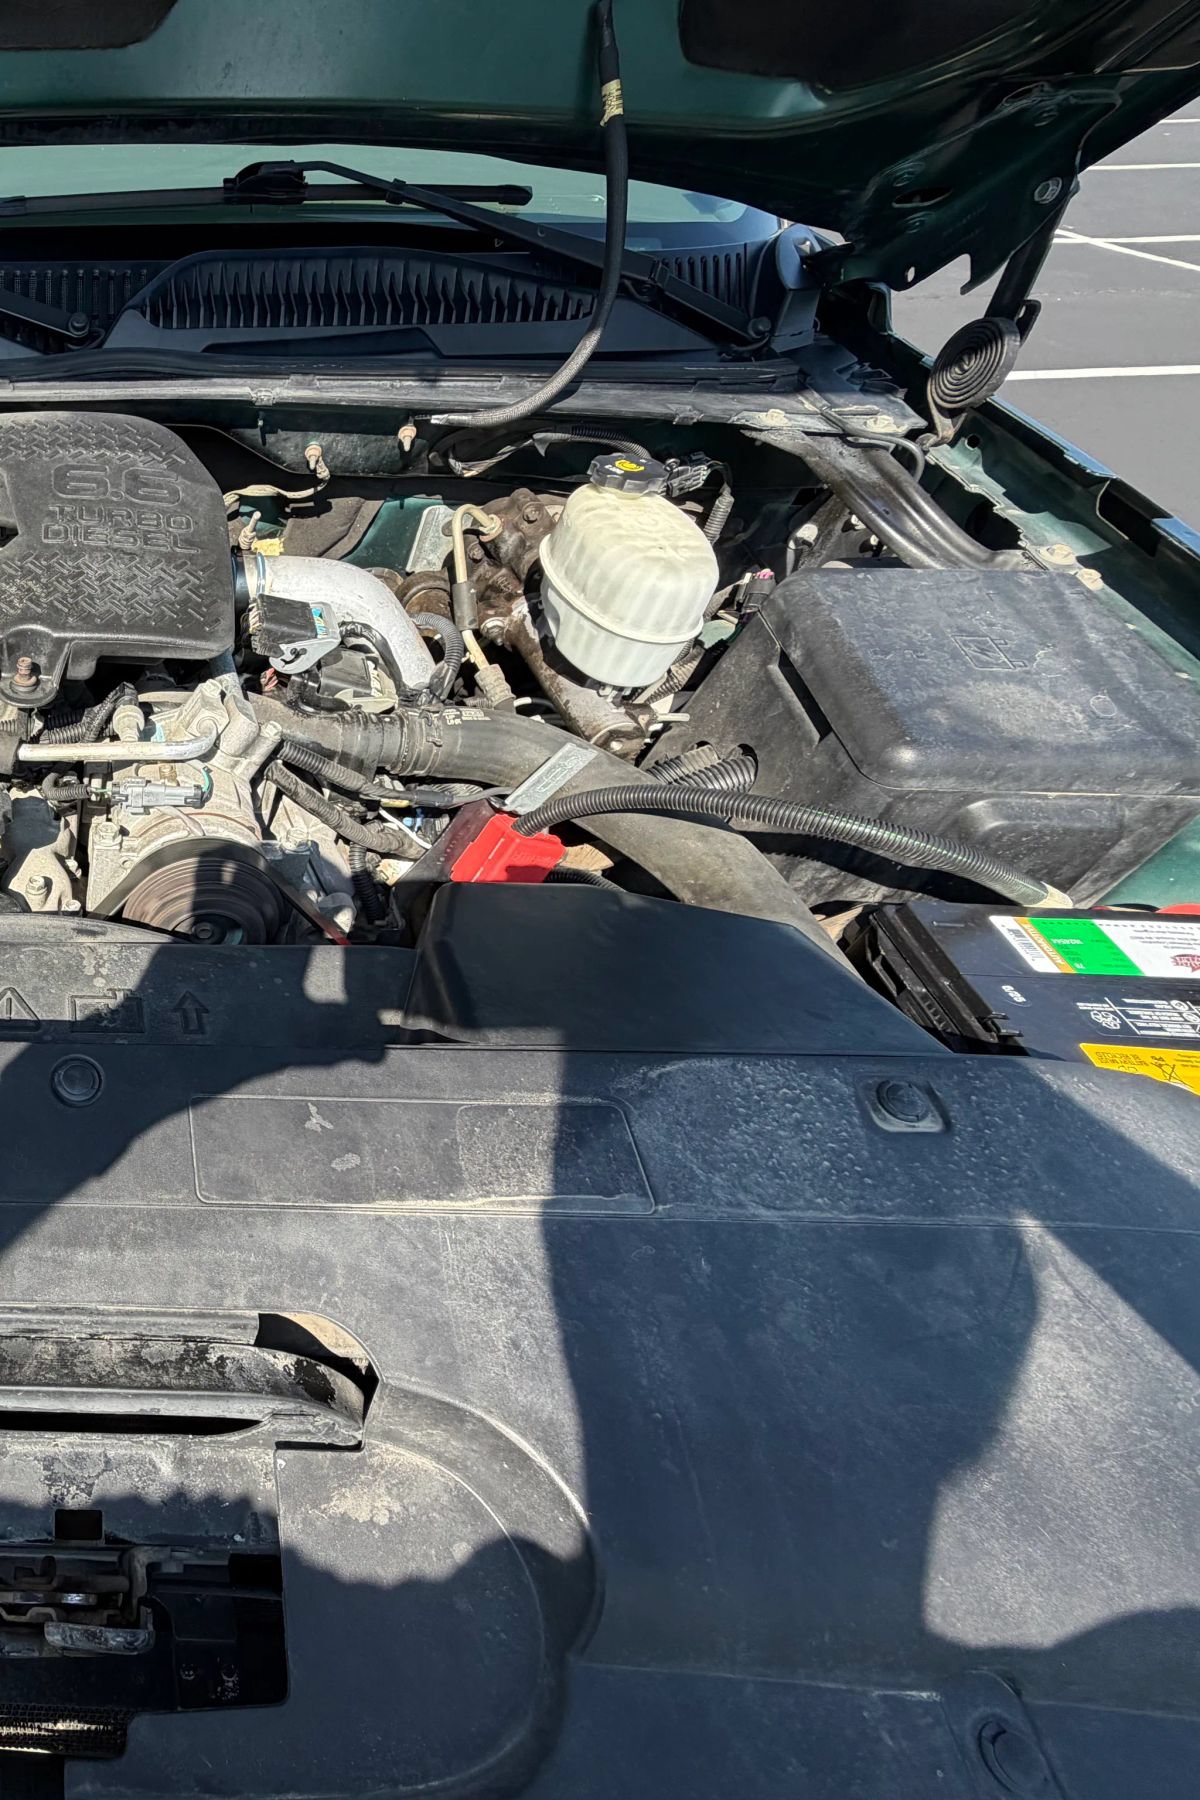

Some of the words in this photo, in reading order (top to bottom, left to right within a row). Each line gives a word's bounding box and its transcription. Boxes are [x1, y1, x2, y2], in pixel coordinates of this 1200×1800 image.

[51, 462, 182, 507] 6.6
[47, 504, 194, 533] TURBO
[41, 523, 201, 554] DIESEL
